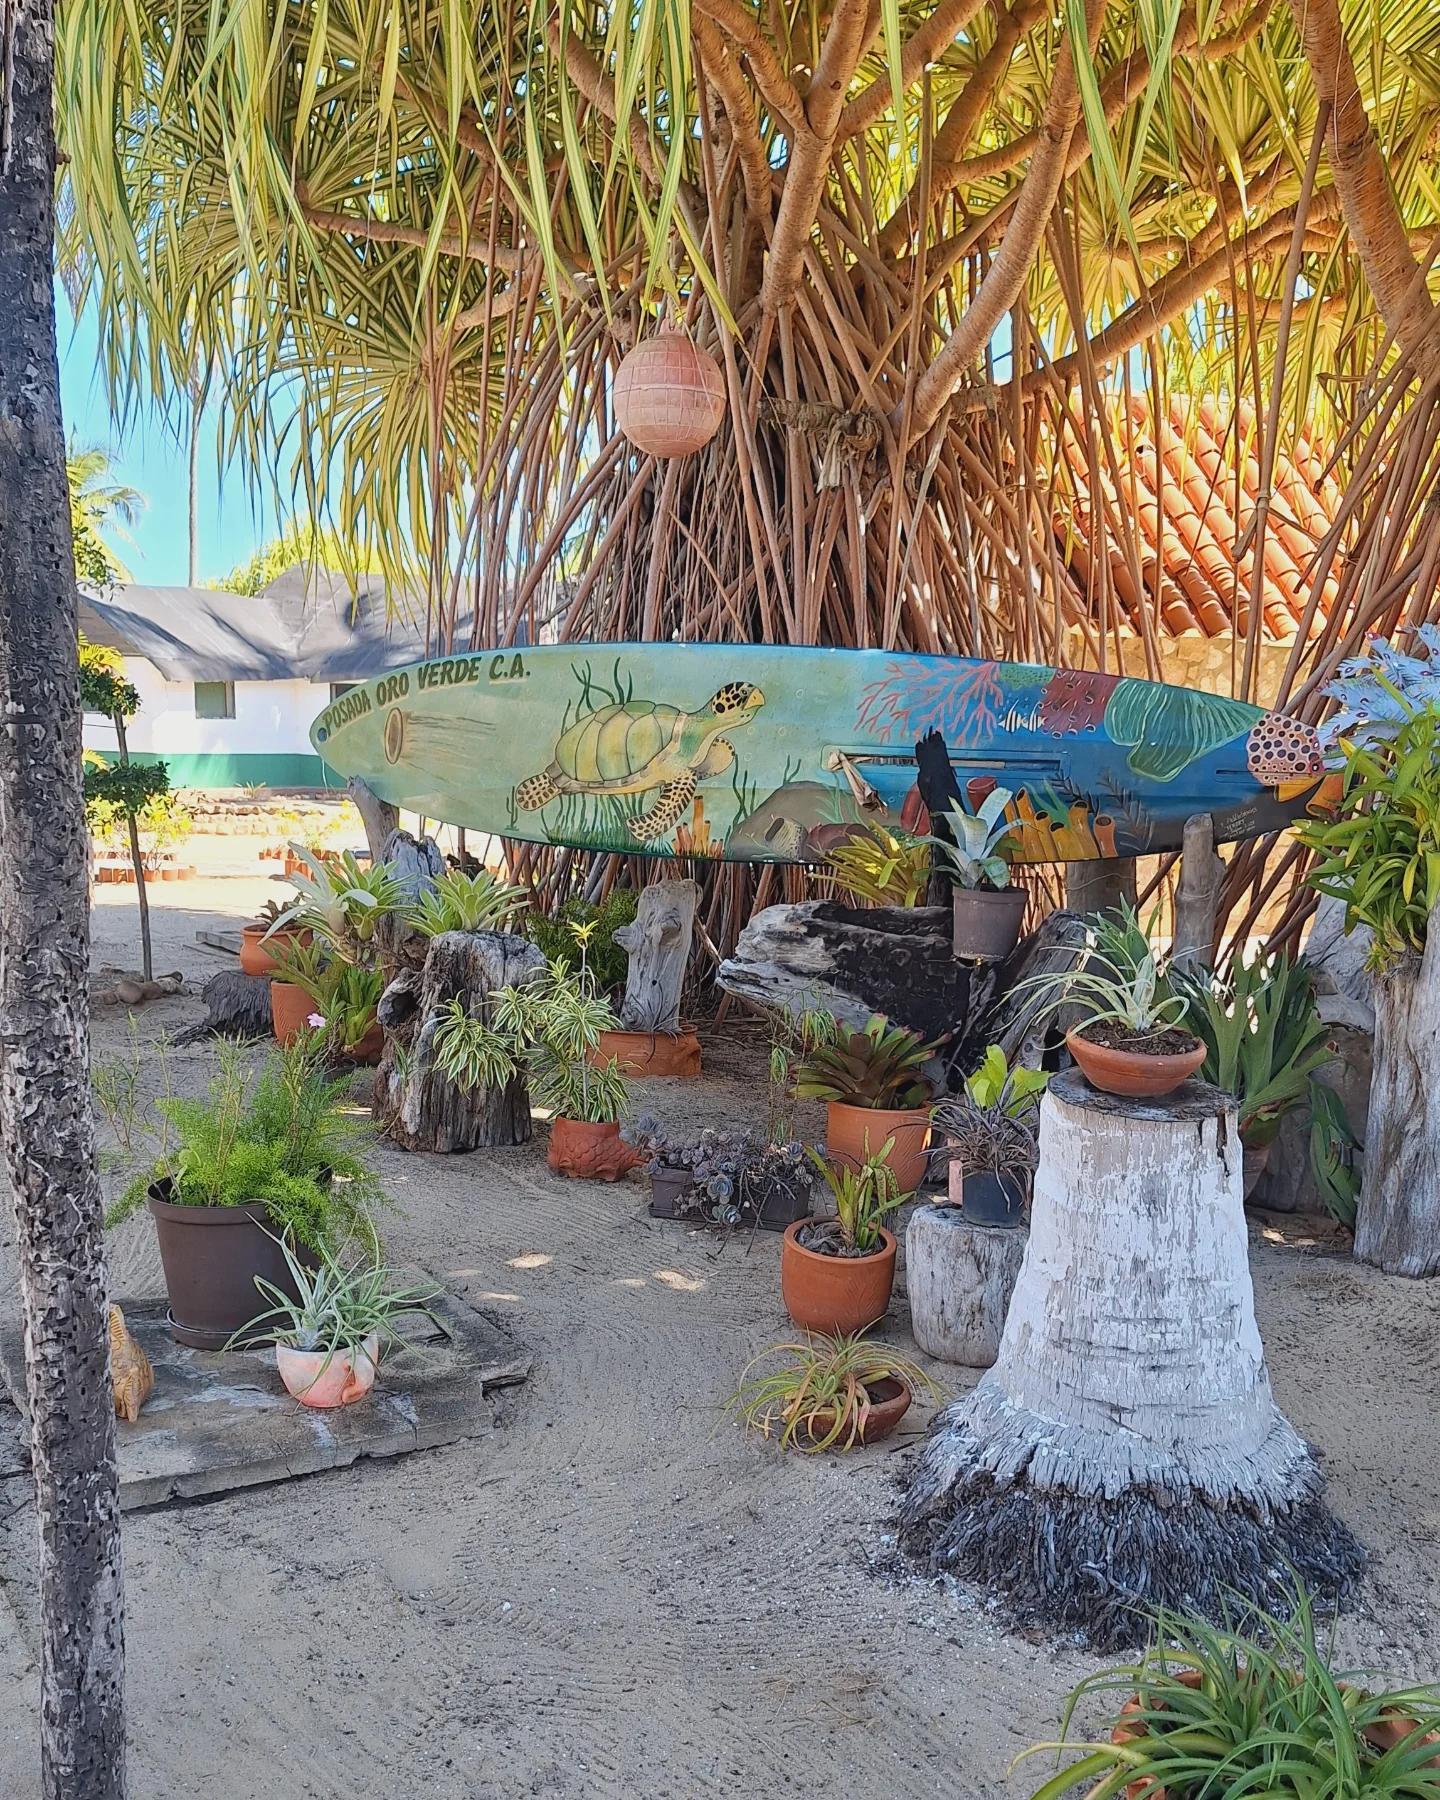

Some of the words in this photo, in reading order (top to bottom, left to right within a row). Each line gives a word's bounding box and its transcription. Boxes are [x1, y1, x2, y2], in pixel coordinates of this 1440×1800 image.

[322, 689, 371, 736] POSADA
[376, 672, 409, 705] ORO
[418, 657, 481, 689] VERDE
[489, 653, 530, 679] C.A.
